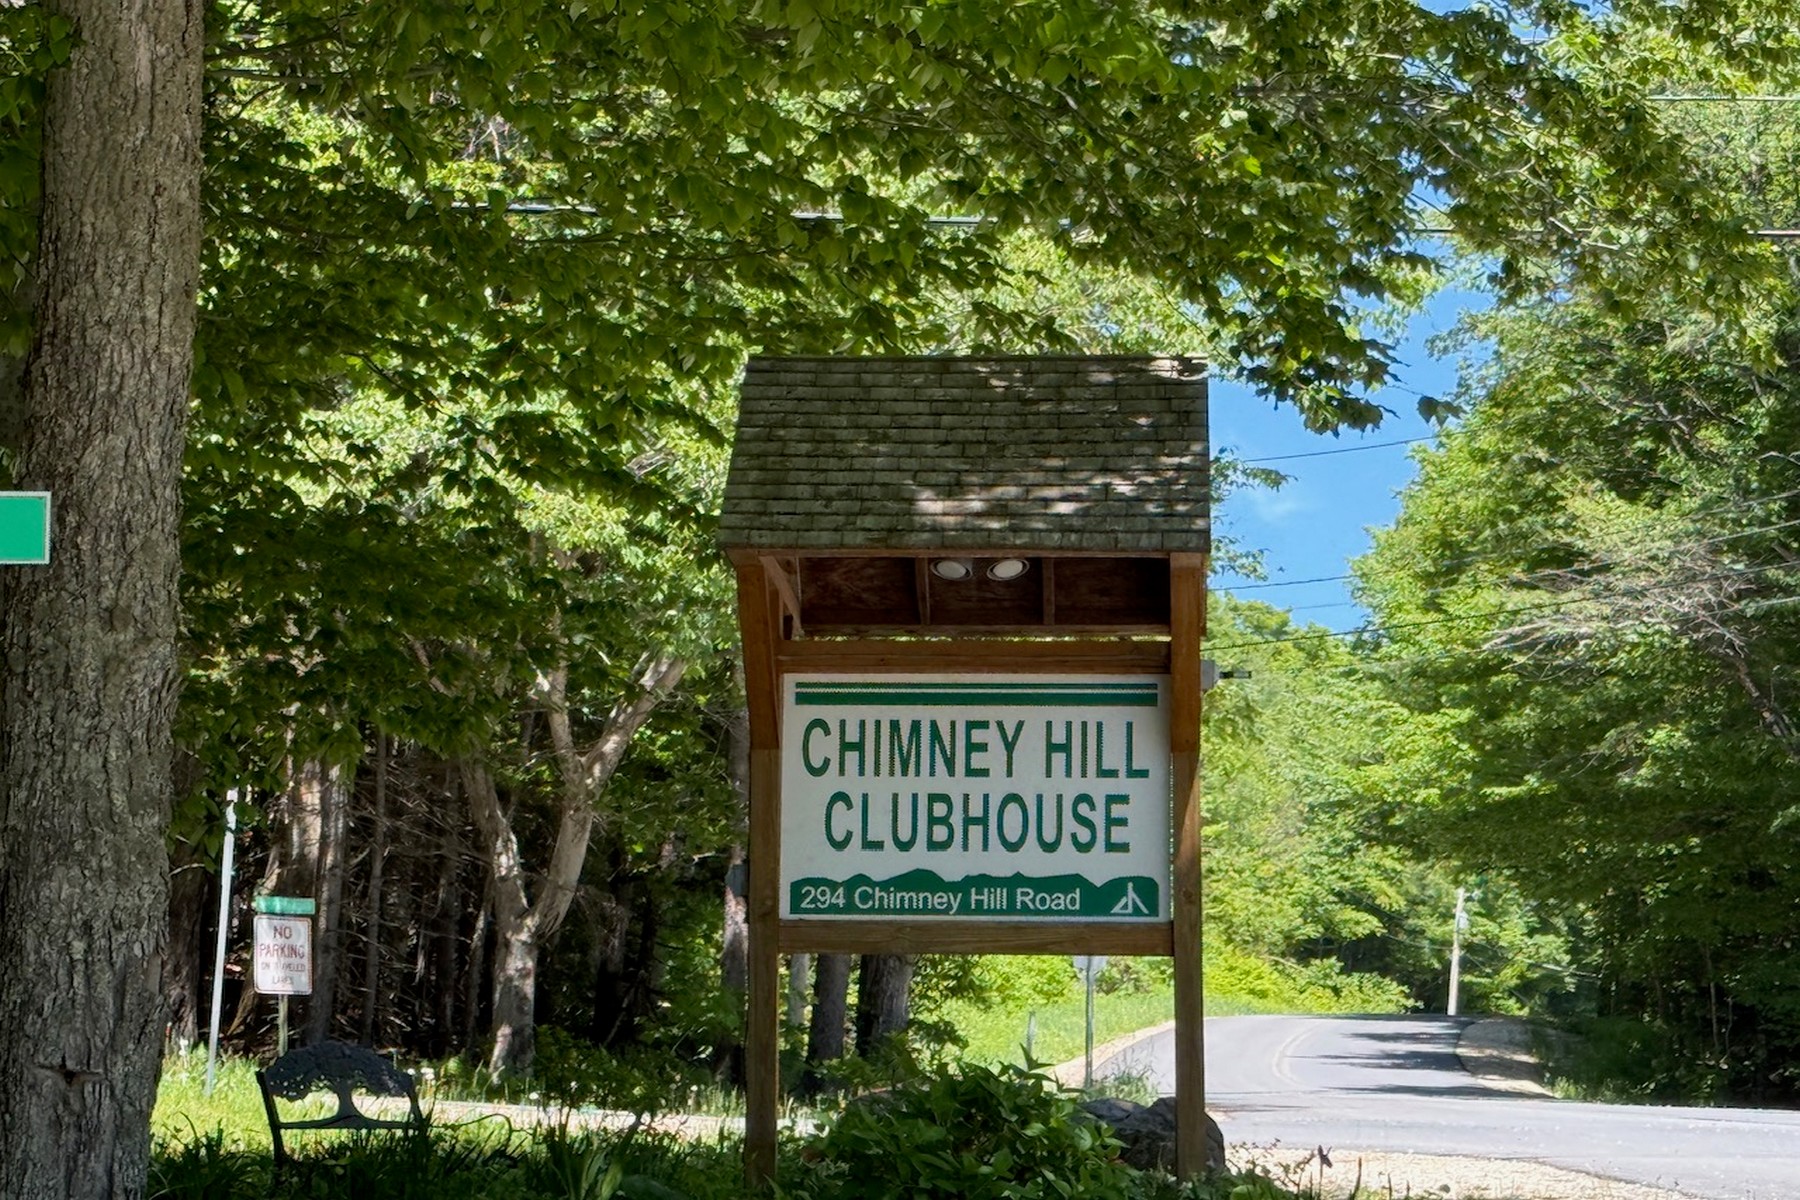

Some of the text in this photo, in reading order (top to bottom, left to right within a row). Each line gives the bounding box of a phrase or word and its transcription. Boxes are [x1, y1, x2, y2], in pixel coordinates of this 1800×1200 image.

[802, 718, 1150, 779] CHIMNEY HILL
[824, 791, 1131, 853] CLUBHOUSE
[800, 886, 1081, 915] 294 Chimney Hill Road
[273, 926, 293, 939] NO
[259, 945, 304, 959] PARKING
